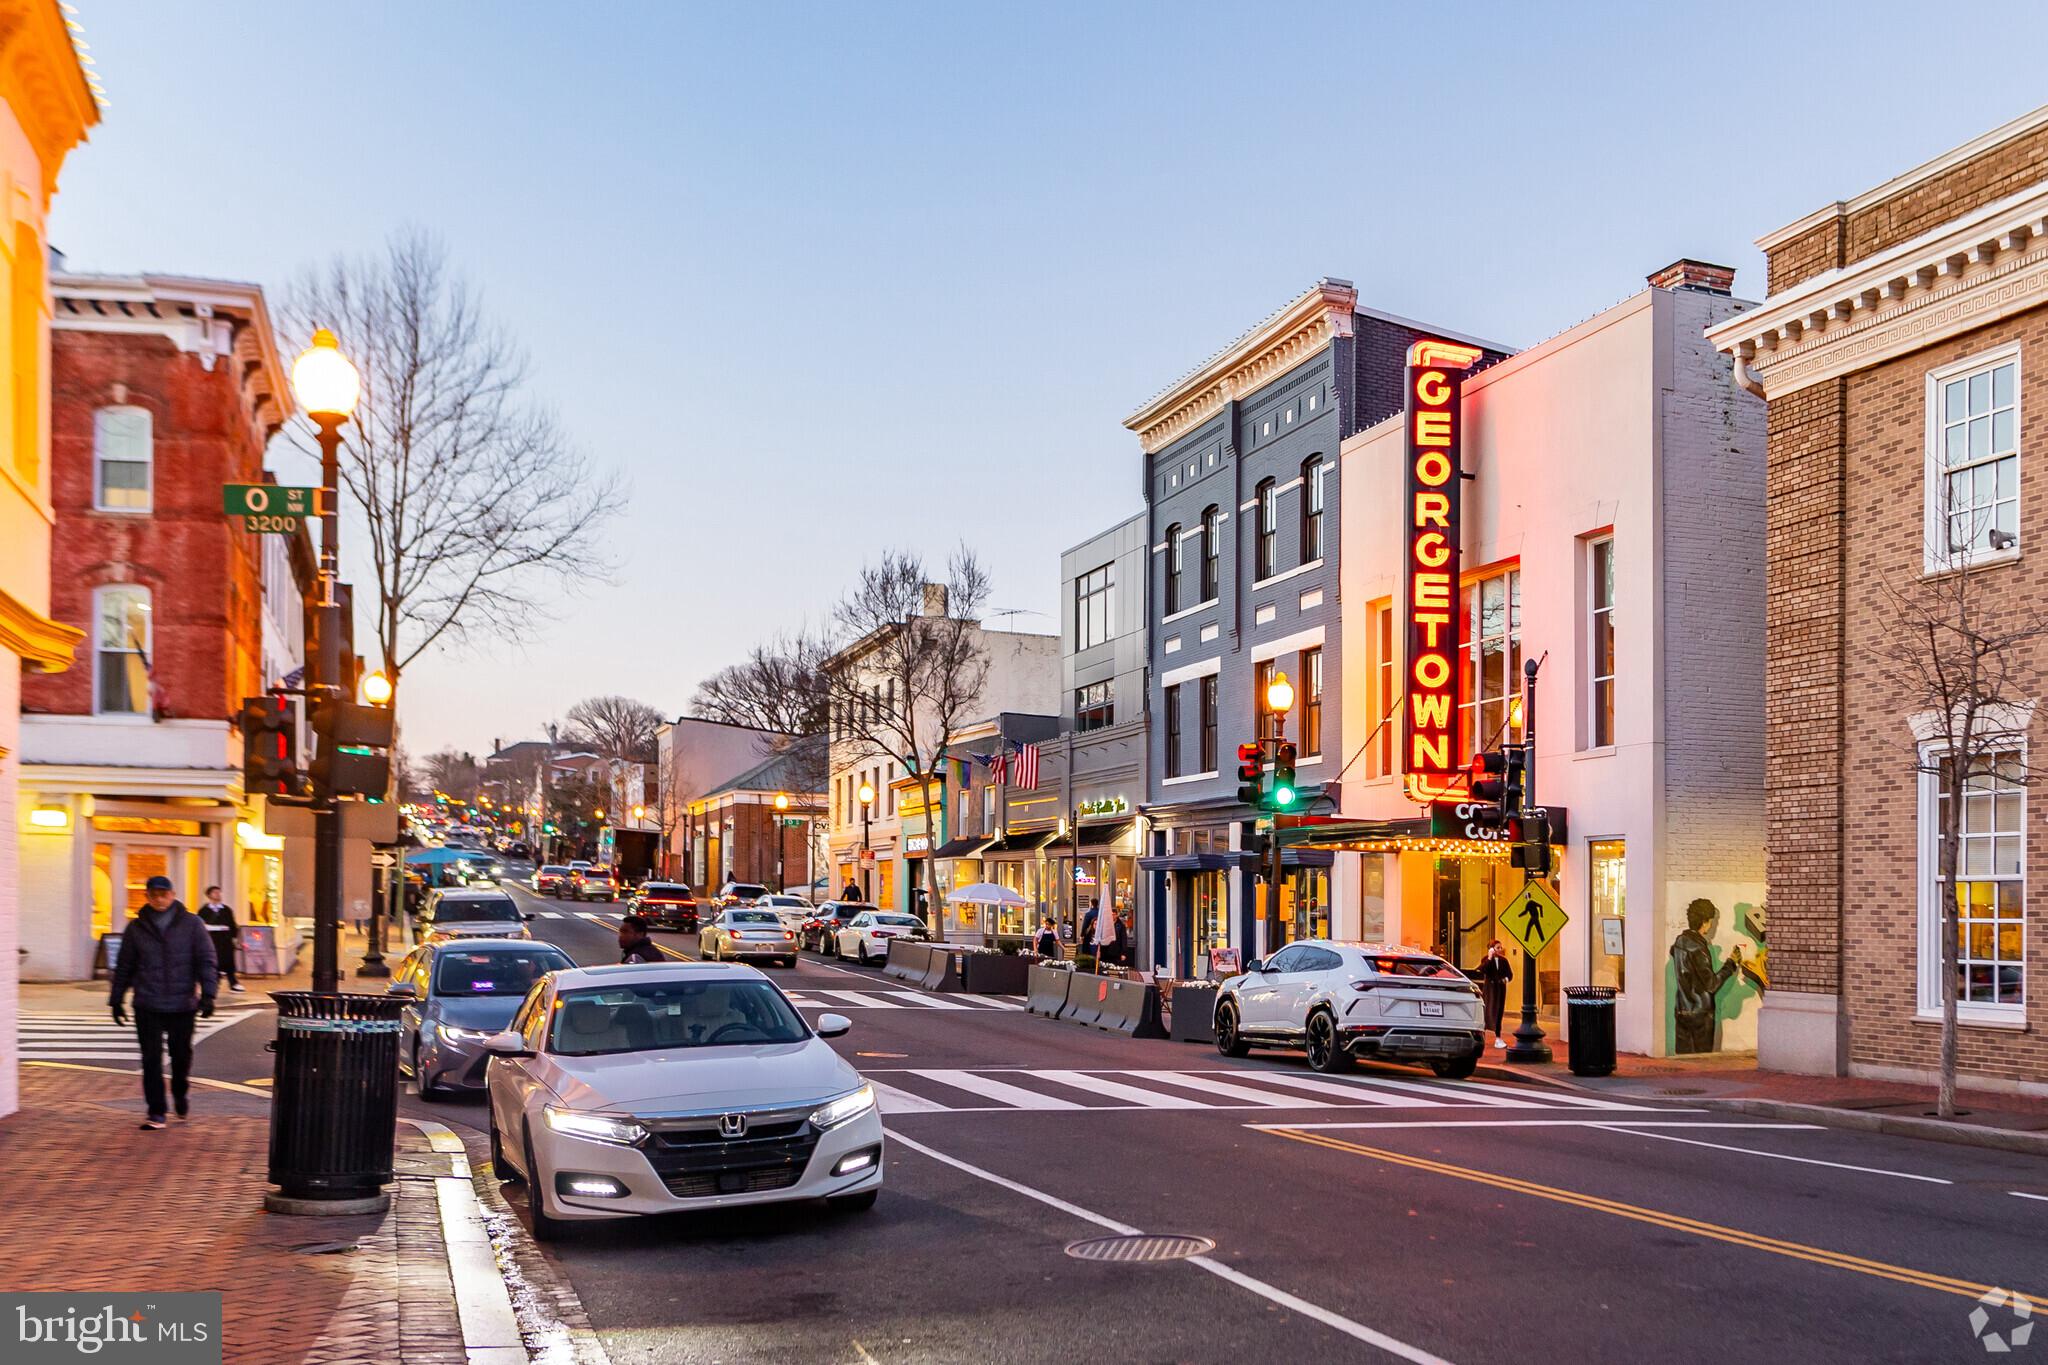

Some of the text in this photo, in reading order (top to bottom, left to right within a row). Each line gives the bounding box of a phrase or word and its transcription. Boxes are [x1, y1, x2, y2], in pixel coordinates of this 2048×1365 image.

[245, 487, 304, 512] O ST
[247, 515, 297, 532] 3200
[1412, 371, 1452, 769] GEORGETOWN
